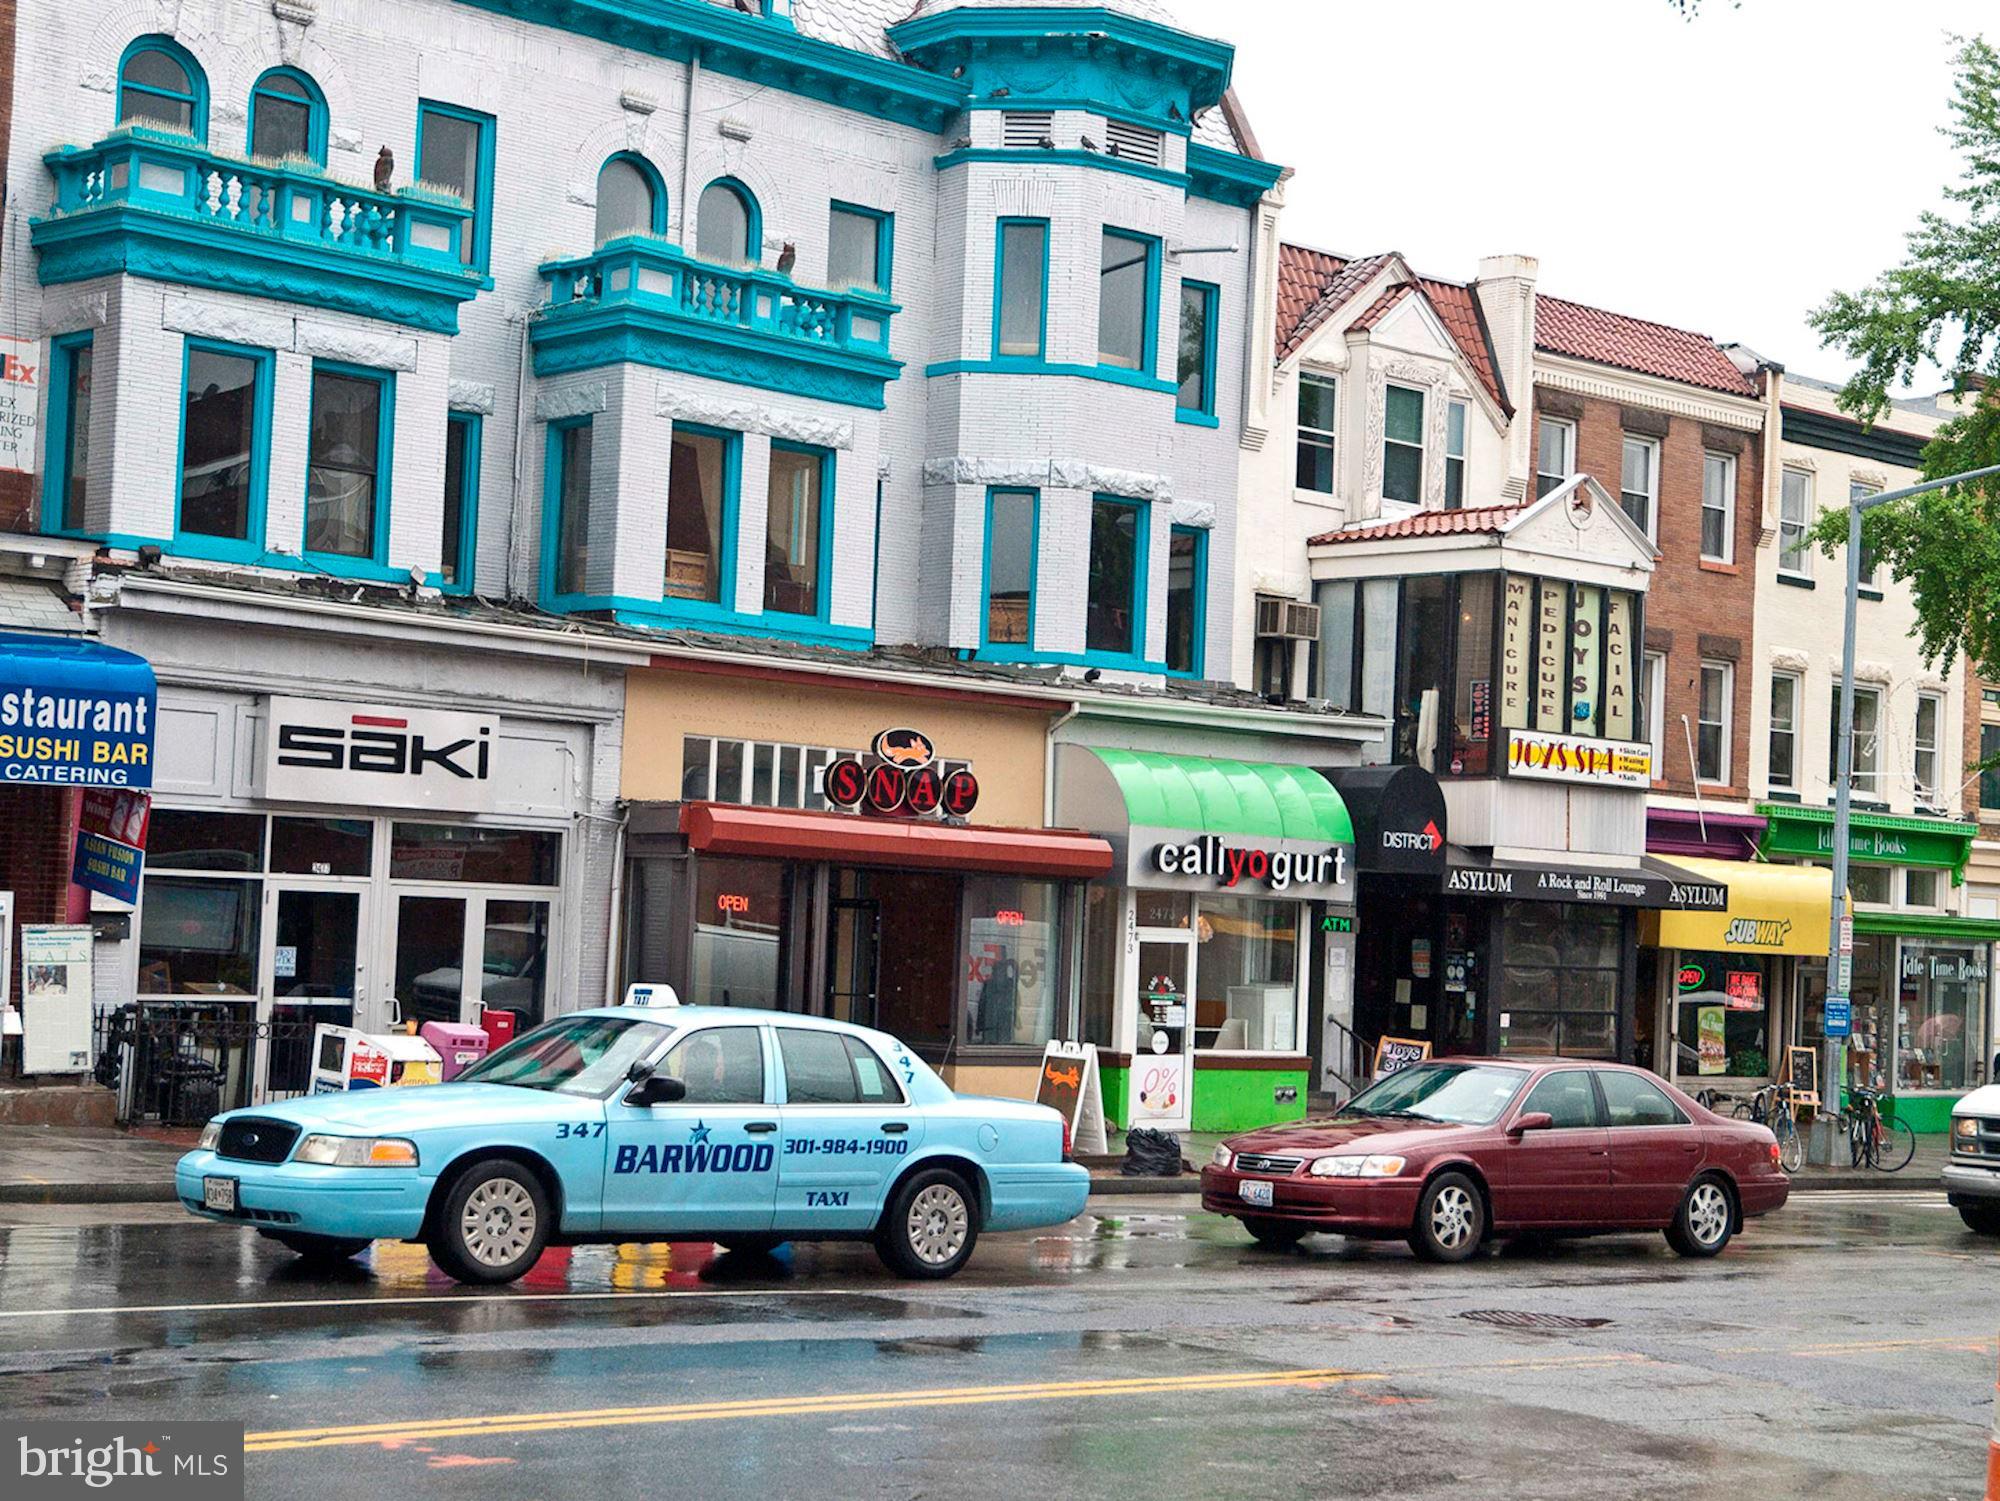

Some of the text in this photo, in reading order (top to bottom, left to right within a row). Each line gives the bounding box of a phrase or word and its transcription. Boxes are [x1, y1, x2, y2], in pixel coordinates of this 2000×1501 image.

[1506, 583, 1524, 708] MANICURE
[1541, 590, 1559, 716] PEDICURE
[1572, 590, 1592, 693] JOYS
[1608, 602, 1624, 717] FACIAL
[1, 688, 147, 735] staurant
[0, 735, 148, 765] SUSHI BAR
[1575, 744, 1615, 779] SPA
[5, 763, 128, 784] CATERING
[838, 764, 975, 809] SNAP
[1382, 830, 1434, 850] DISTRICT
[1874, 832, 1907, 855] Books
[108, 846, 135, 865] FUSION
[1158, 835, 1346, 891] caliyogurt
[88, 857, 127, 882] SUSHI BAR
[1448, 870, 1513, 893] ASYLUM
[1537, 873, 1646, 897] A Rock and Roll Lounge
[1669, 885, 1725, 906] ASYLUM
[718, 894, 749, 911] OPEN
[996, 910, 1024, 926] OPEN
[1321, 918, 1350, 932] ATM
[1127, 910, 1135, 954] 2473
[1725, 917, 1791, 946] SUBWAY
[1903, 954, 1924, 978] Idle
[1958, 957, 1988, 980] Books
[891, 1040, 914, 1084] 347
[1144, 1068, 1178, 1093] 0%
[556, 1122, 607, 1139] 347
[614, 1144, 774, 1174] BARWOOD
[783, 1139, 908, 1154] 301-984-1900
[806, 1191, 850, 1207] TAXI
